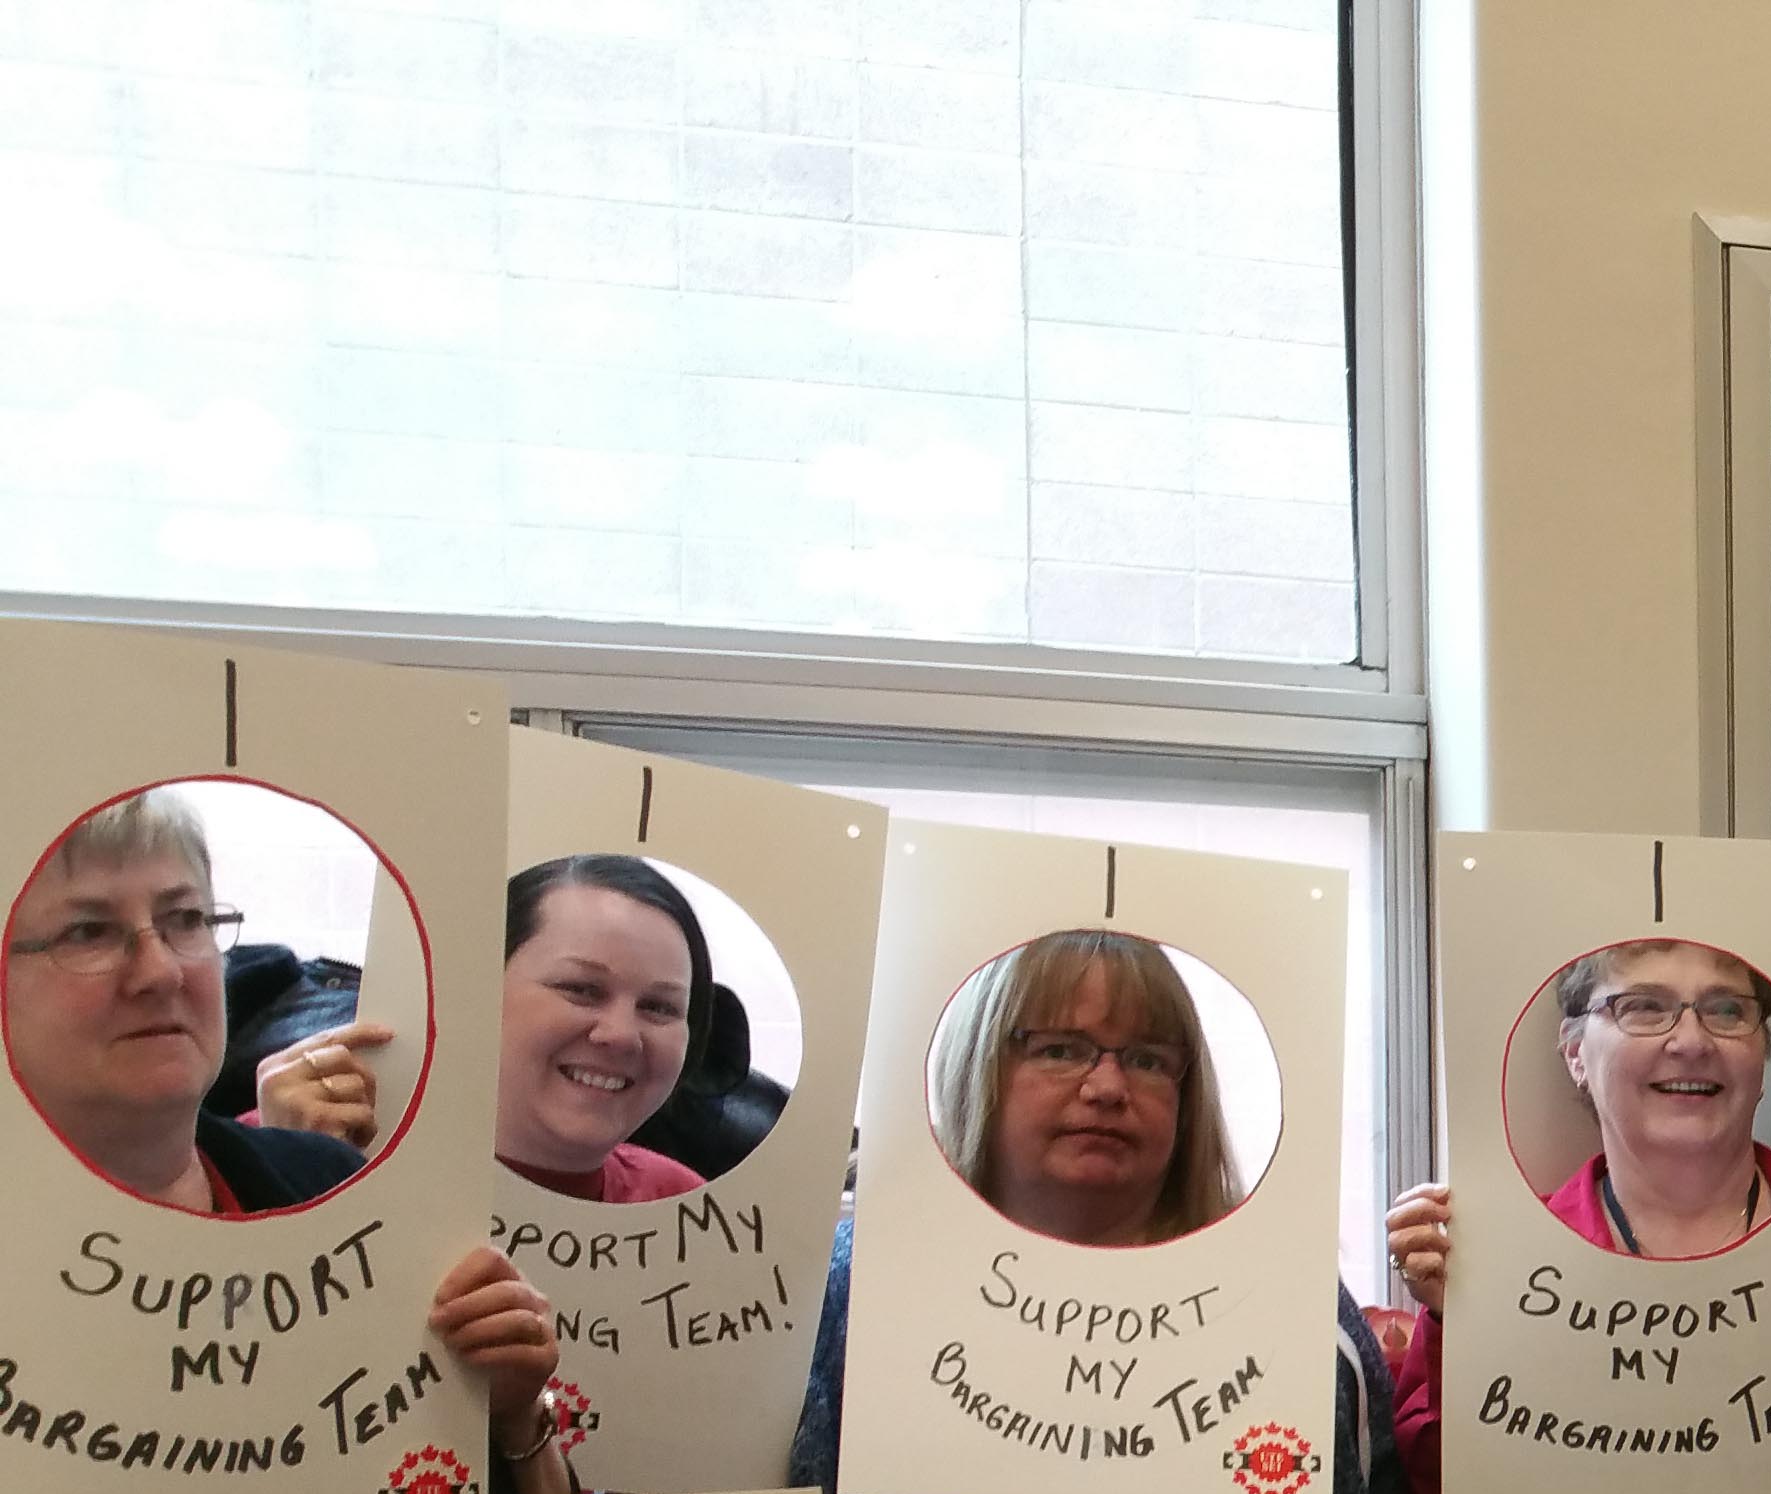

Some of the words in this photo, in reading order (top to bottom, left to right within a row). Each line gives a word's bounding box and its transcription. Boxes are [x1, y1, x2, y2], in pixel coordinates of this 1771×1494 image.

[641, 1264, 793, 1349] TEAM!
[980, 1251, 1220, 1343] SUPPORT
[1518, 1265, 1764, 1338] SUPPORT
[170, 1341, 260, 1392] MY
[318, 1351, 442, 1455] TEAM
[930, 1341, 1154, 1460] BARGAINING
[1153, 1355, 1264, 1443] TEAM
[1065, 1354, 1138, 1400] MY
[1611, 1346, 1679, 1385] MY
[1478, 1375, 1720, 1454] BARGAINING
